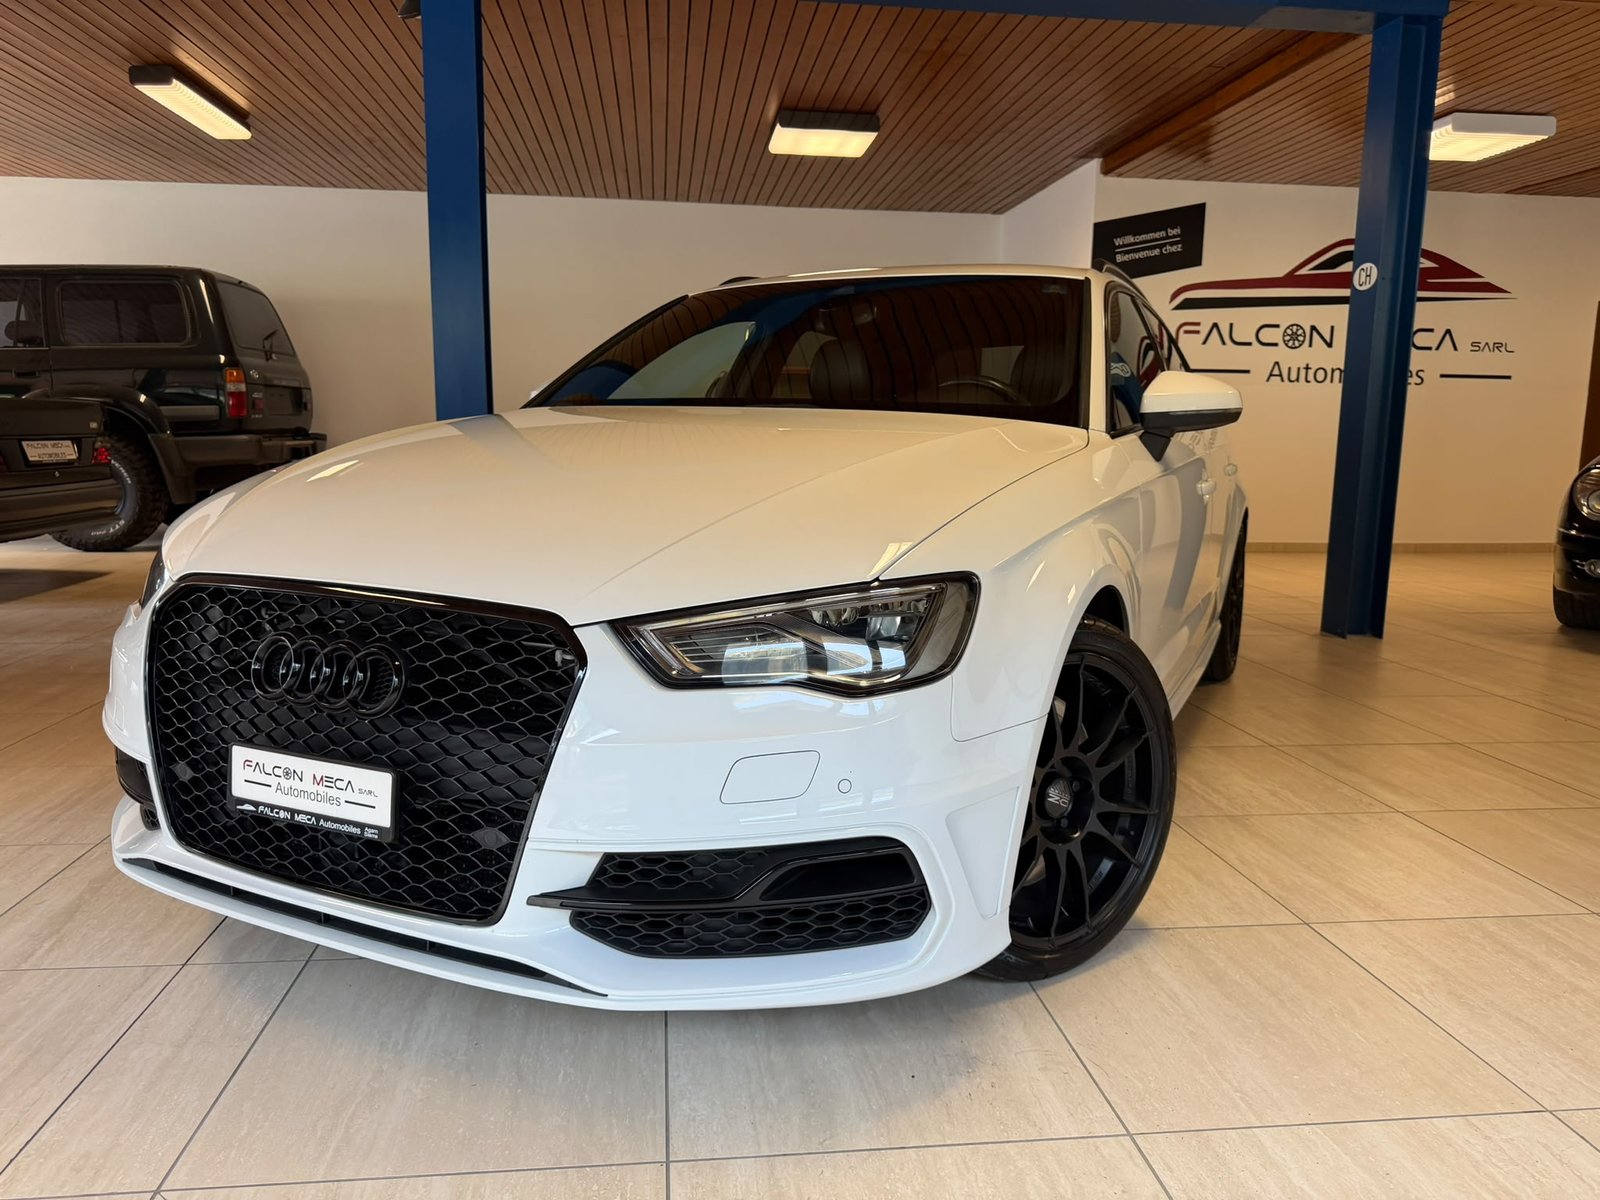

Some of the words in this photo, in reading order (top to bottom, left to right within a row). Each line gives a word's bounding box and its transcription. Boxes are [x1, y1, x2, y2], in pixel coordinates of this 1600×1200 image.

[1113, 230, 1166, 247] Willkommen
[1167, 225, 1181, 237] bei
[1115, 246, 1160, 263] Bienvenue
[1162, 243, 1183, 254] chez
[1358, 266, 1373, 287] CH
[1178, 321, 1335, 350] FALCON
[1470, 341, 1515, 354] SARL
[242, 759, 304, 783] FALCON
[312, 773, 355, 794] MECA
[358, 787, 379, 798] SARL
[275, 782, 342, 807] Automobiles
[257, 805, 291, 820] FALCON
[294, 813, 317, 826] MECA
[319, 818, 361, 835] Automobiles
